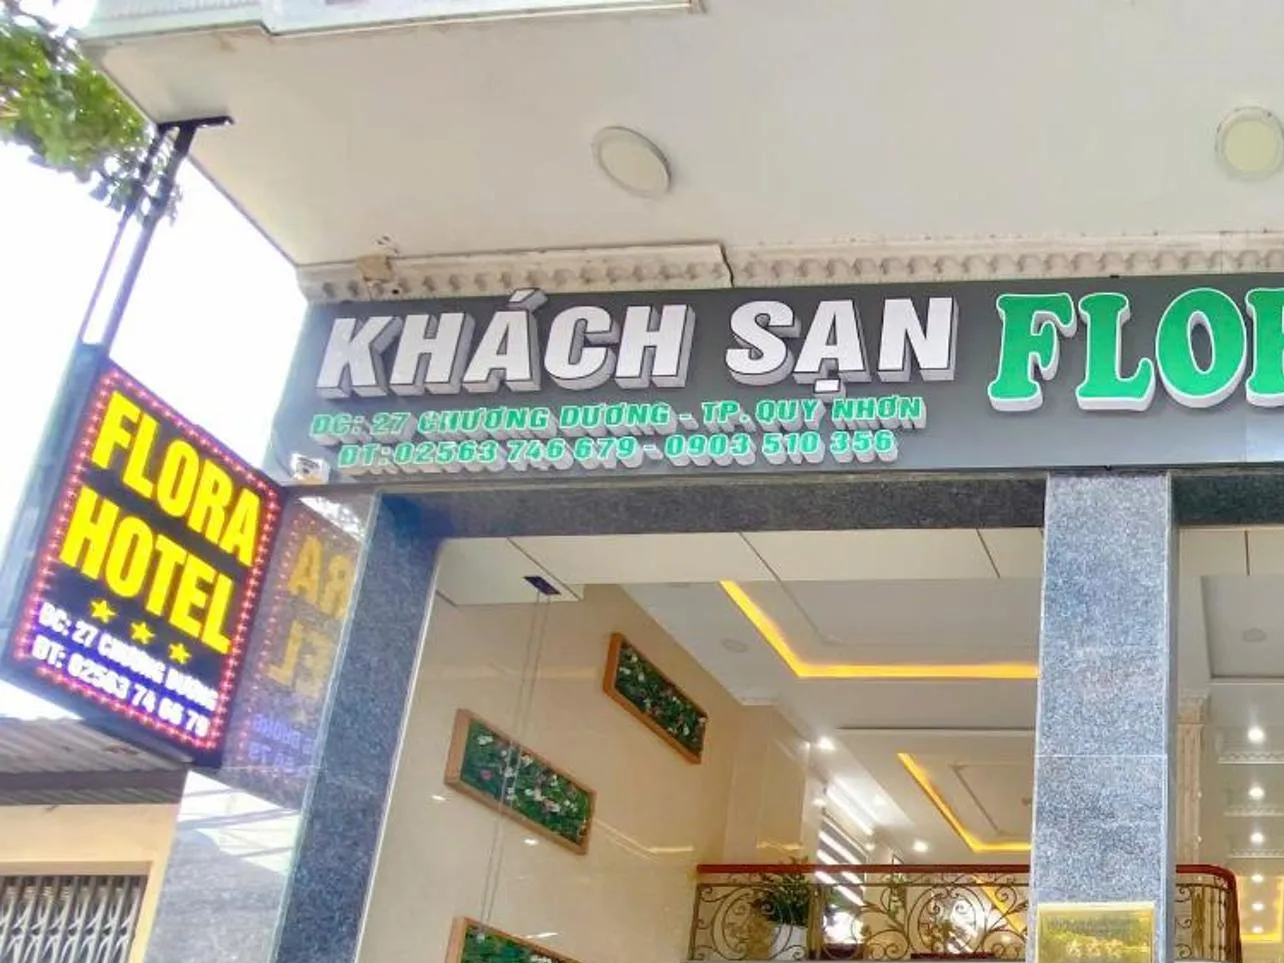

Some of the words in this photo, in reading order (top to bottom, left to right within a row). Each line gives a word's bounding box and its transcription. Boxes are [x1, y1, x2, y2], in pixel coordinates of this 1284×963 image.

[317, 289, 692, 395] KHÁCH
[725, 297, 957, 398] SẠN
[370, 411, 412, 435] 27
[832, 395, 926, 421] NHƠN
[507, 438, 567, 463] 746
[573, 436, 639, 460] 679
[664, 432, 752, 457] 0903
[761, 430, 822, 455] 510
[830, 429, 896, 454] 356
[91, 391, 262, 568] FLORA
[60, 486, 234, 655] HOTEL
